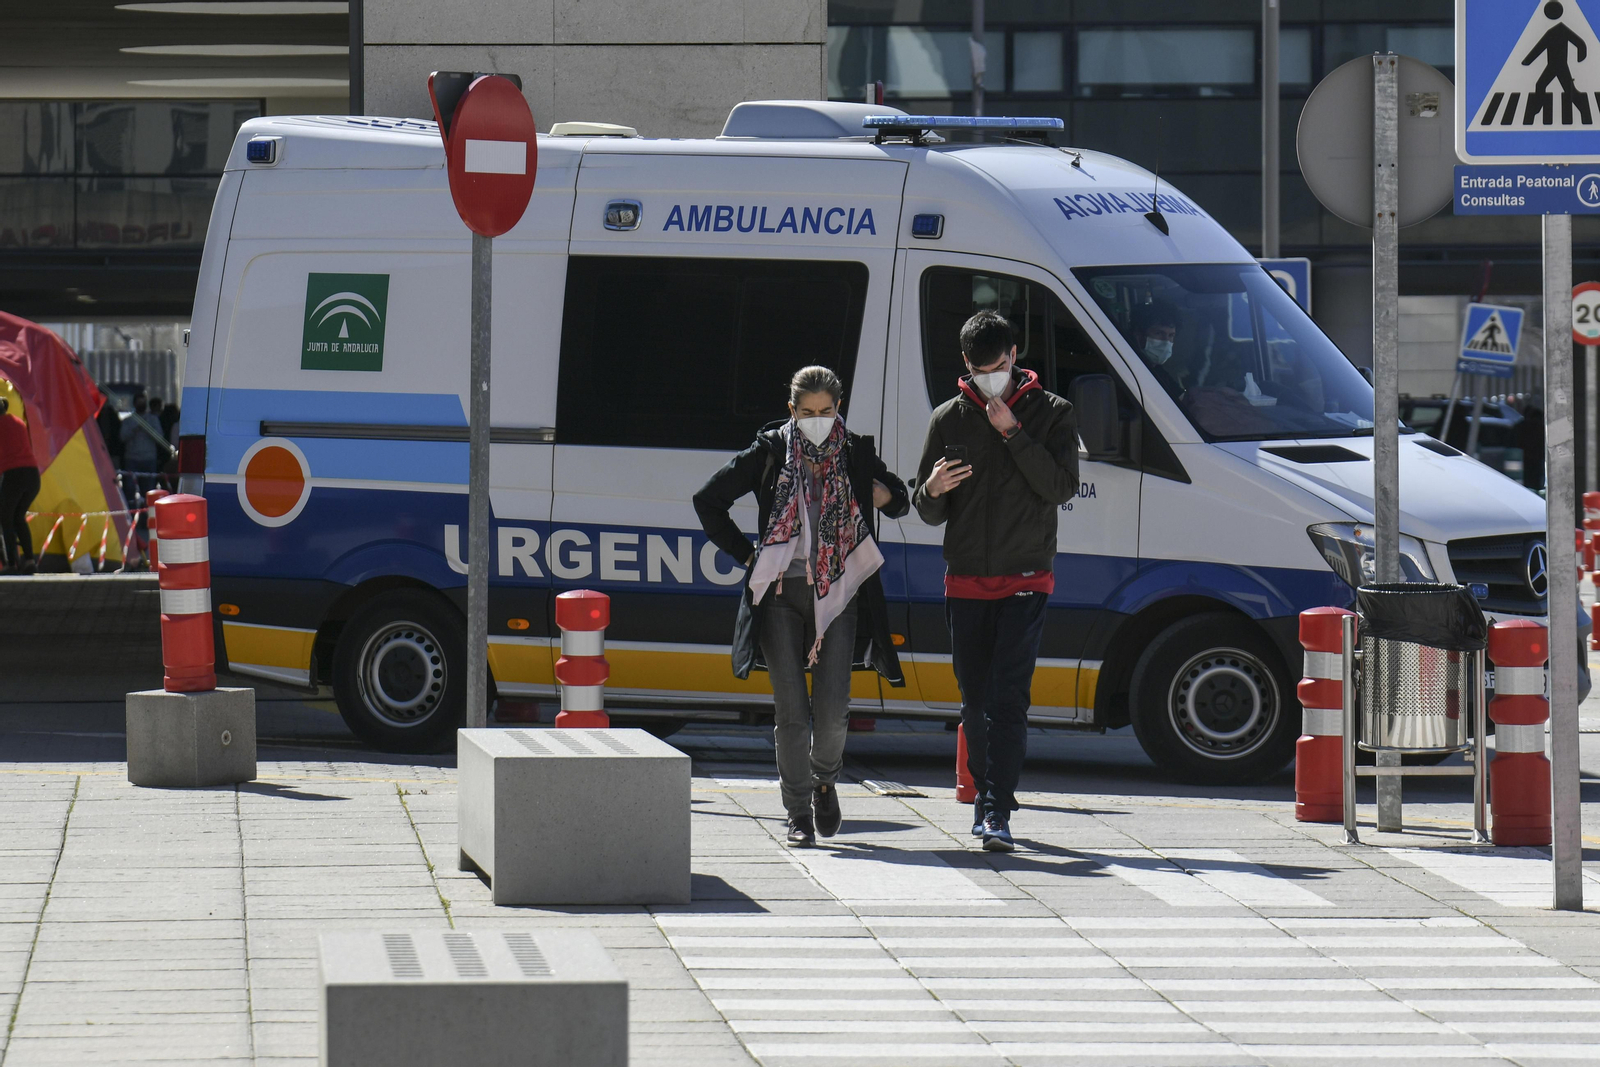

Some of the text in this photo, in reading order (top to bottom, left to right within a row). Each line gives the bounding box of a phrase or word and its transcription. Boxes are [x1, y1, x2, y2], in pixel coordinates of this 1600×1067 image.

[1461, 174, 1575, 188] Entrada Peatonal
[1461, 193, 1525, 206] Consultas
[662, 204, 877, 236] AMBULANCIA
[307, 342, 379, 353] JUNTA DE ANDALUCIA
[444, 524, 747, 586] URGENC
